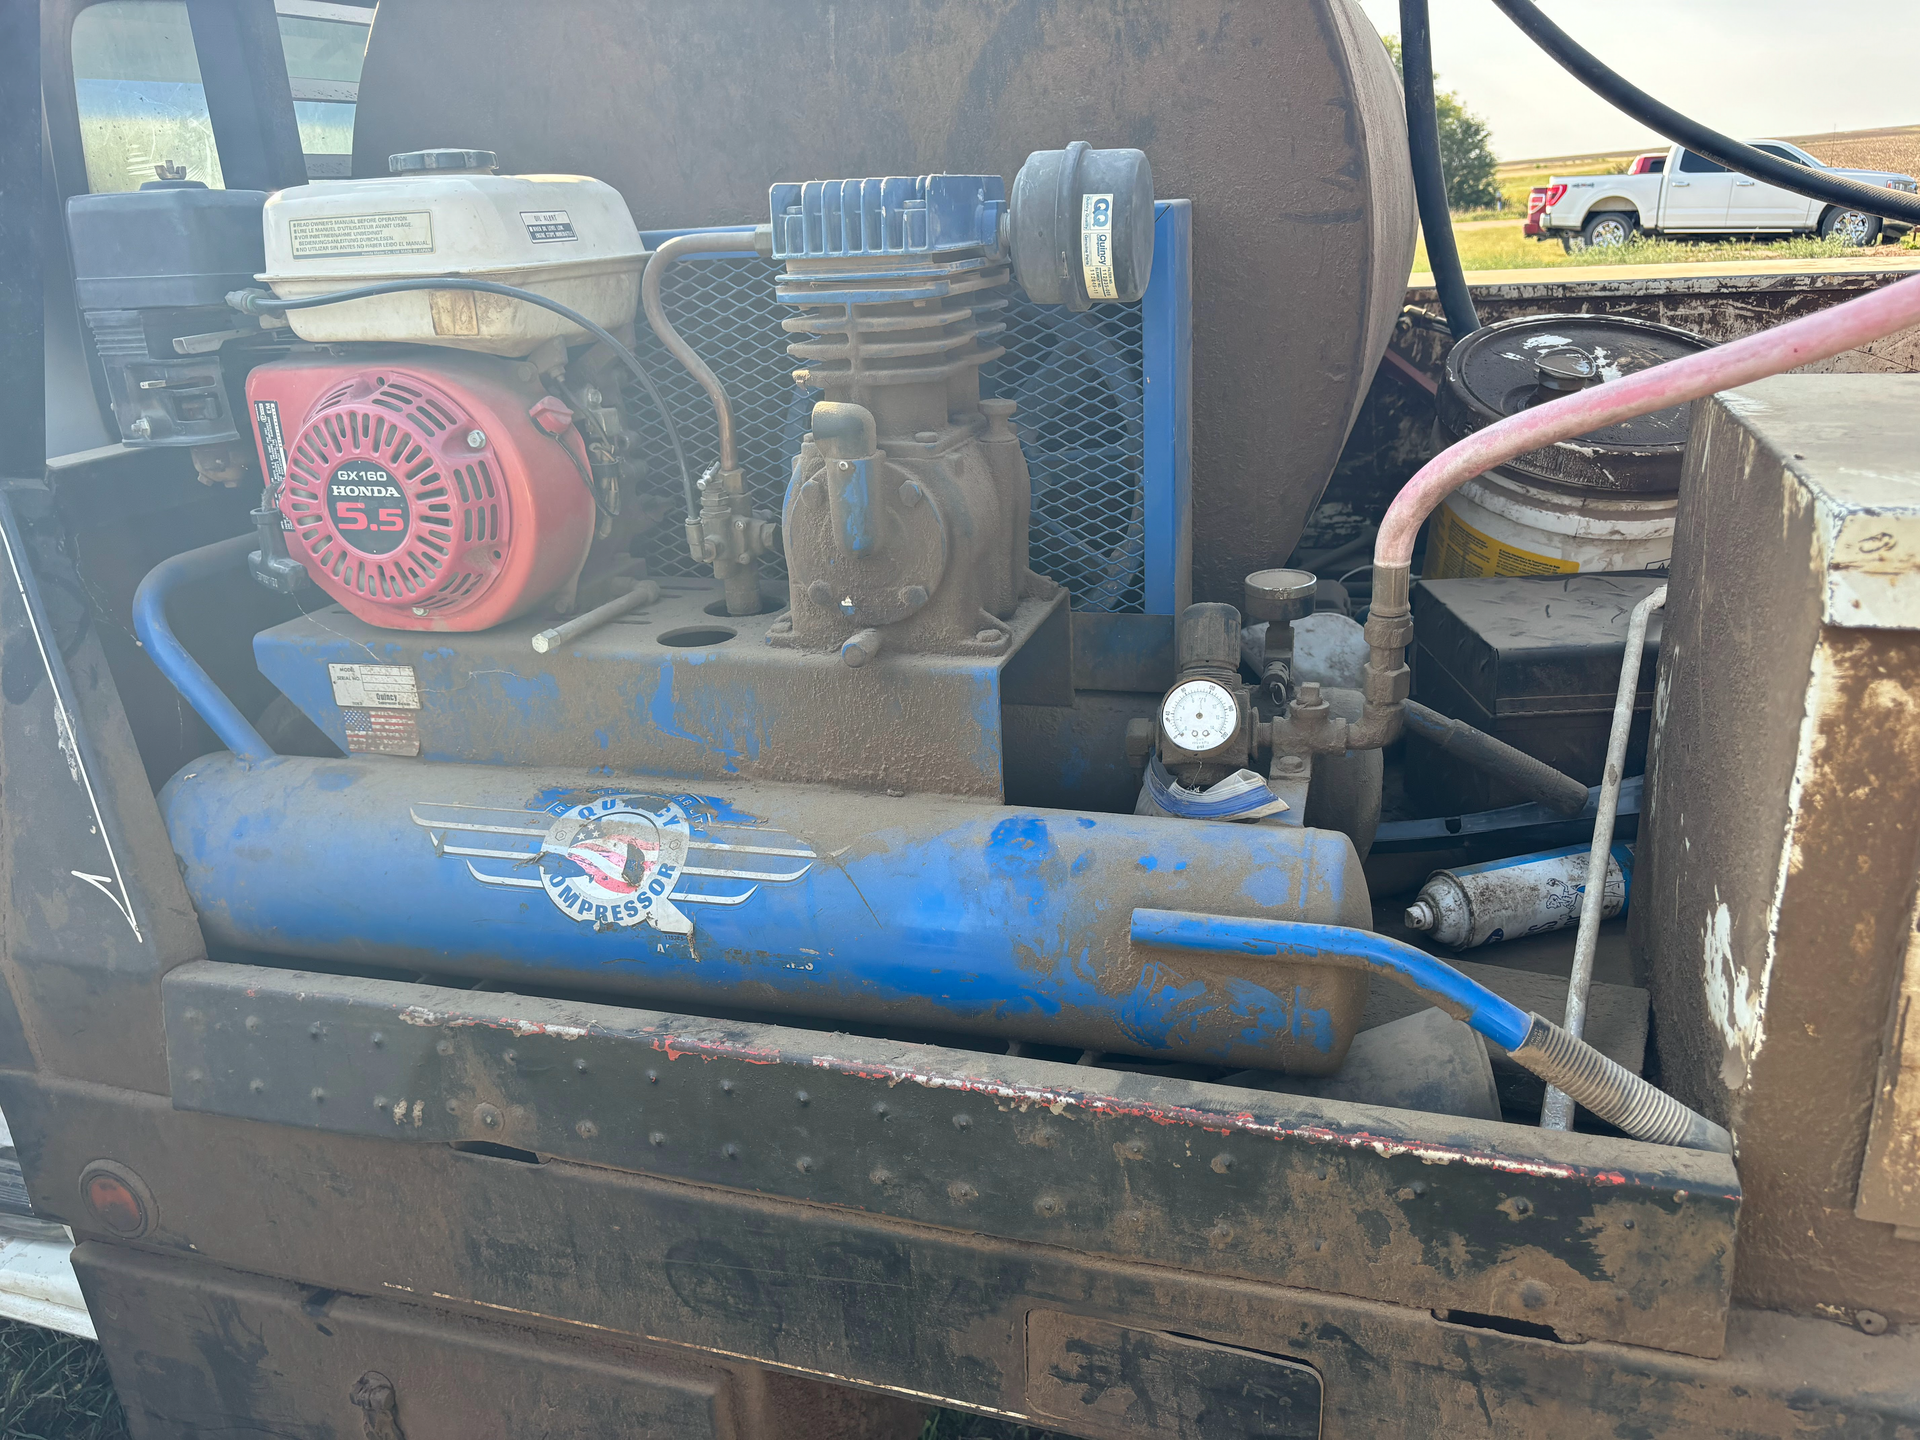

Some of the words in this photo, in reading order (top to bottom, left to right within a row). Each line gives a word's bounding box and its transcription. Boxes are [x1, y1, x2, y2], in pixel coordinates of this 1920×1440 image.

[1098, 234, 1108, 265] Quincy
[338, 471, 387, 481] GX160
[331, 485, 401, 497] HONDA
[336, 502, 404, 531] 5.5
[376, 693, 397, 701] Quincy
[578, 799, 681, 827] QUCY
[550, 862, 676, 922] OMPRESSOR
